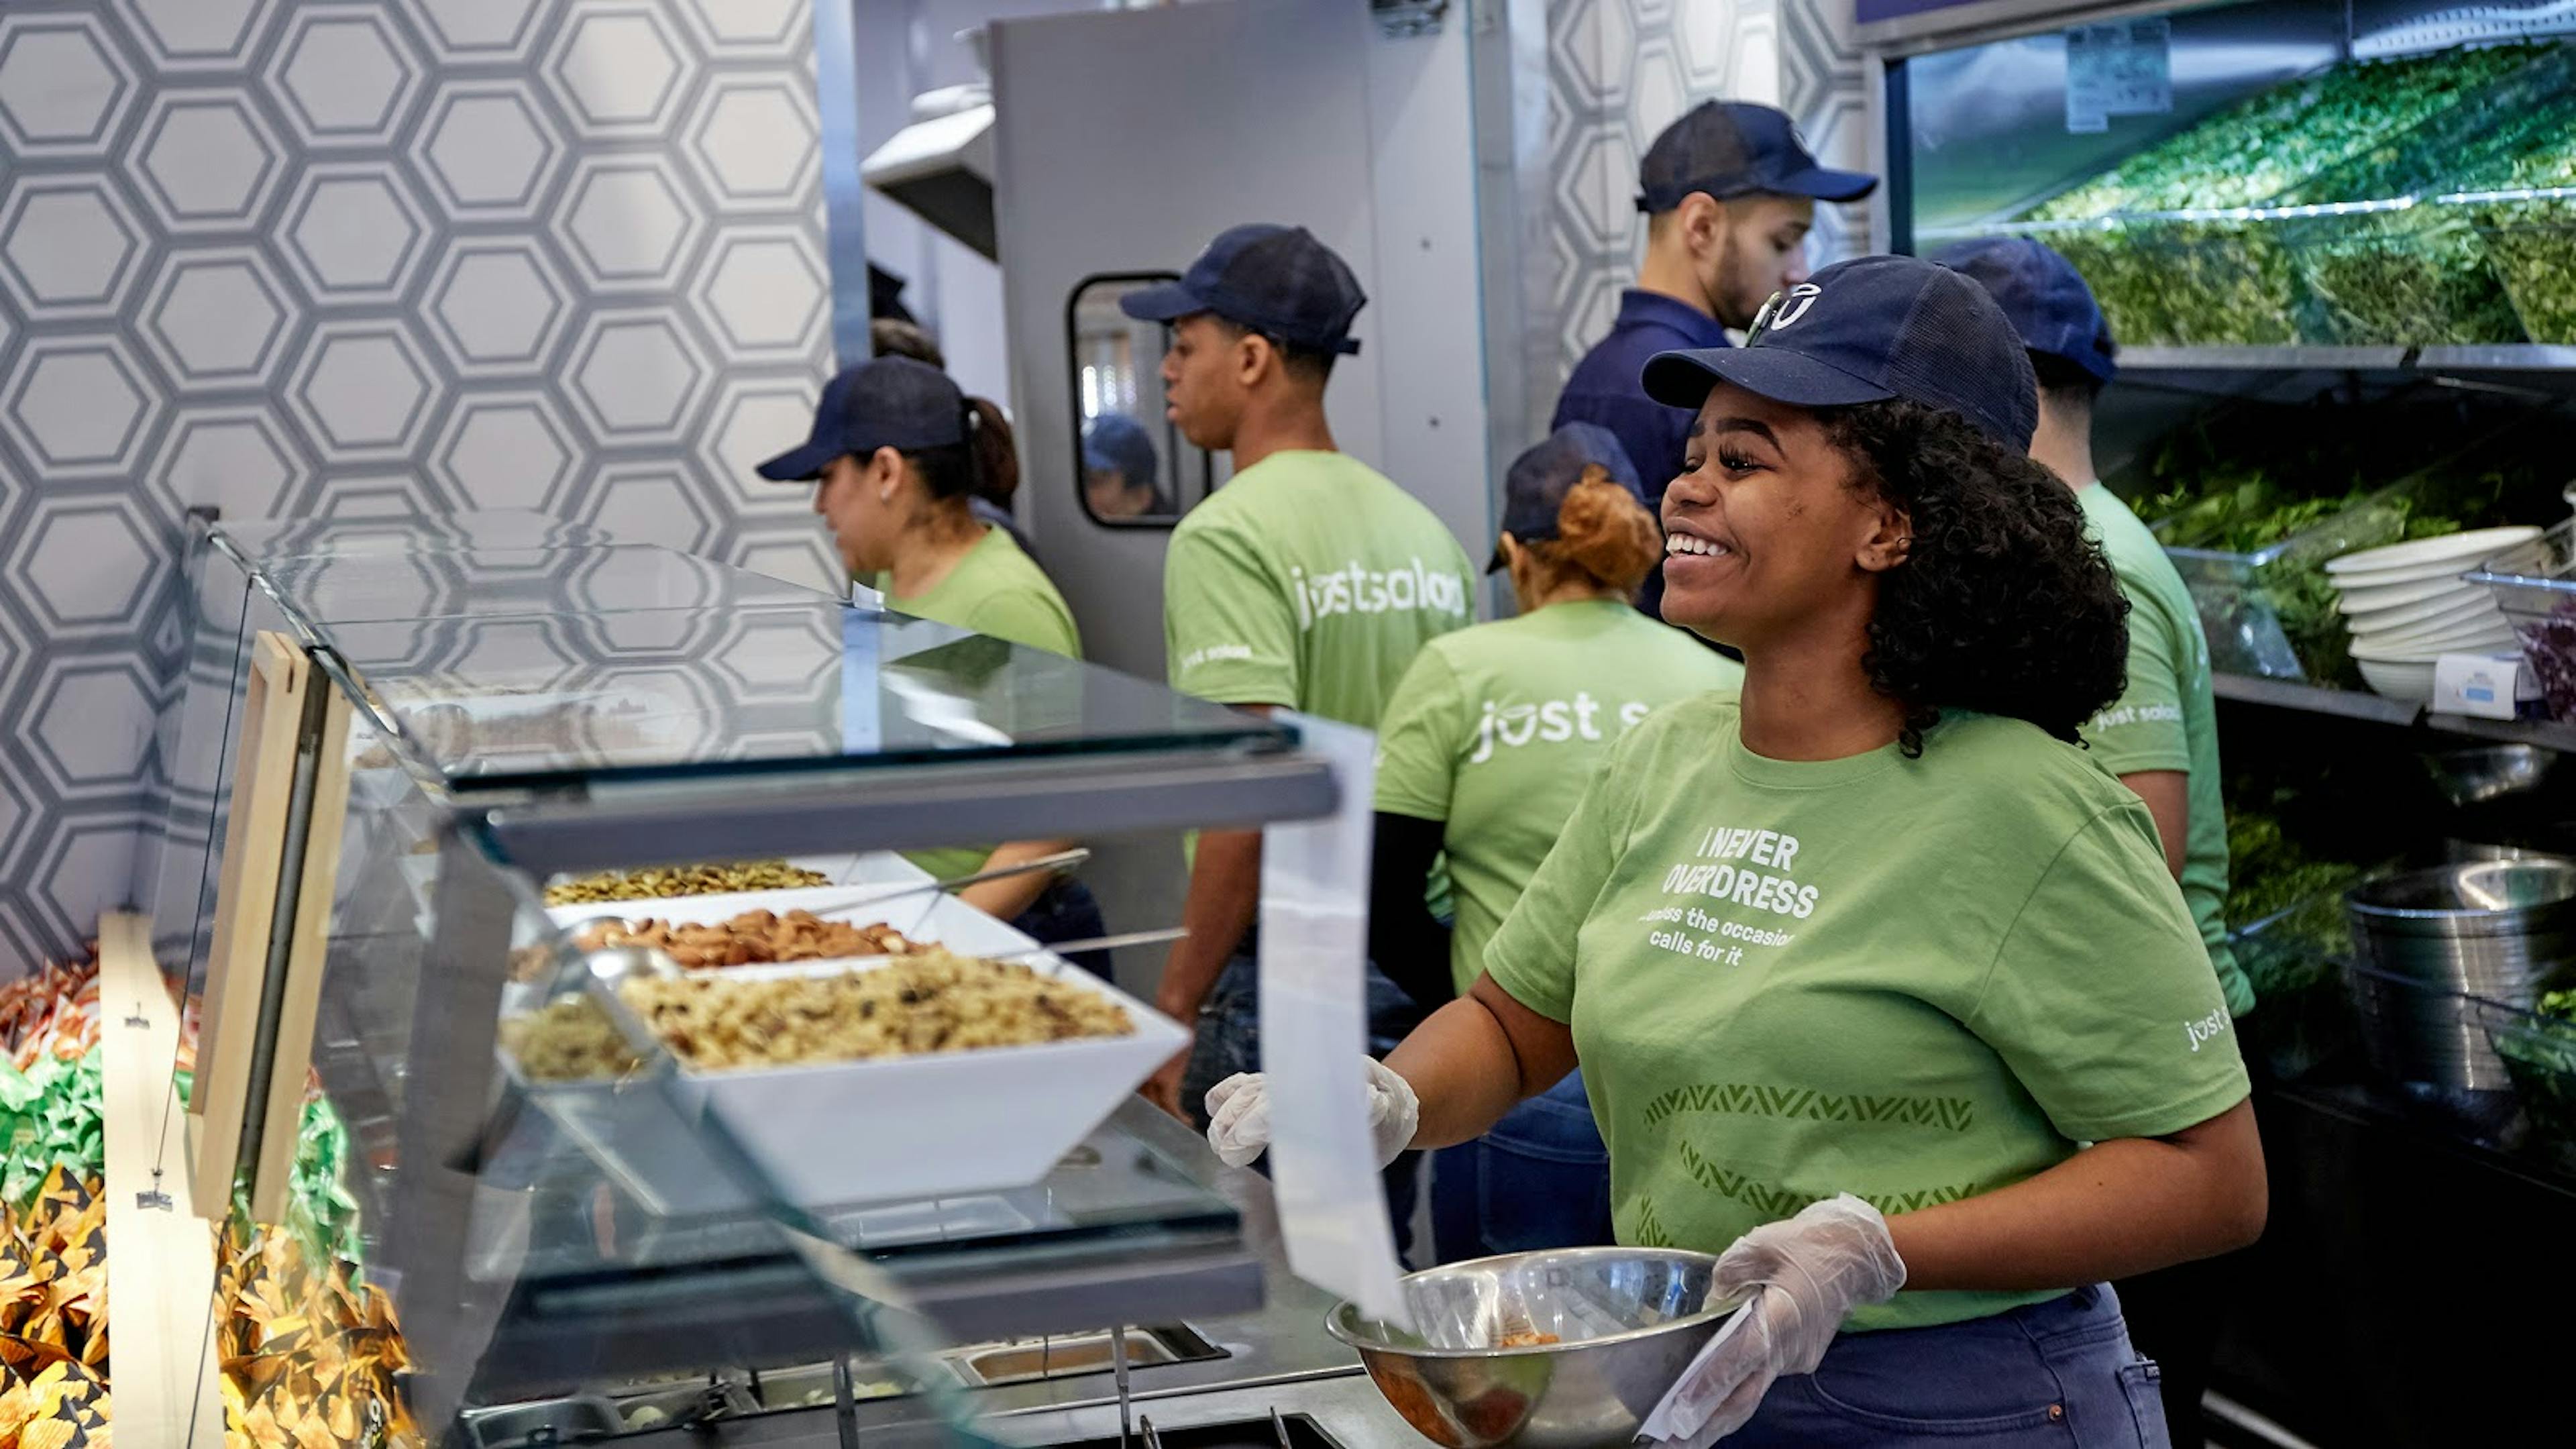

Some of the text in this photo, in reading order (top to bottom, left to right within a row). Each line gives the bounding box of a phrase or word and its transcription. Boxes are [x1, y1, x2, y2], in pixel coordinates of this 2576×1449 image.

[1471, 692, 1601, 763] just
[1696, 826, 1800, 872] I NEVER
[1662, 863, 1819, 919] OVERDRESS
[1686, 907, 1719, 933] the
[1649, 930, 1743, 966] calls for it
[2184, 1008, 2224, 1052] just
